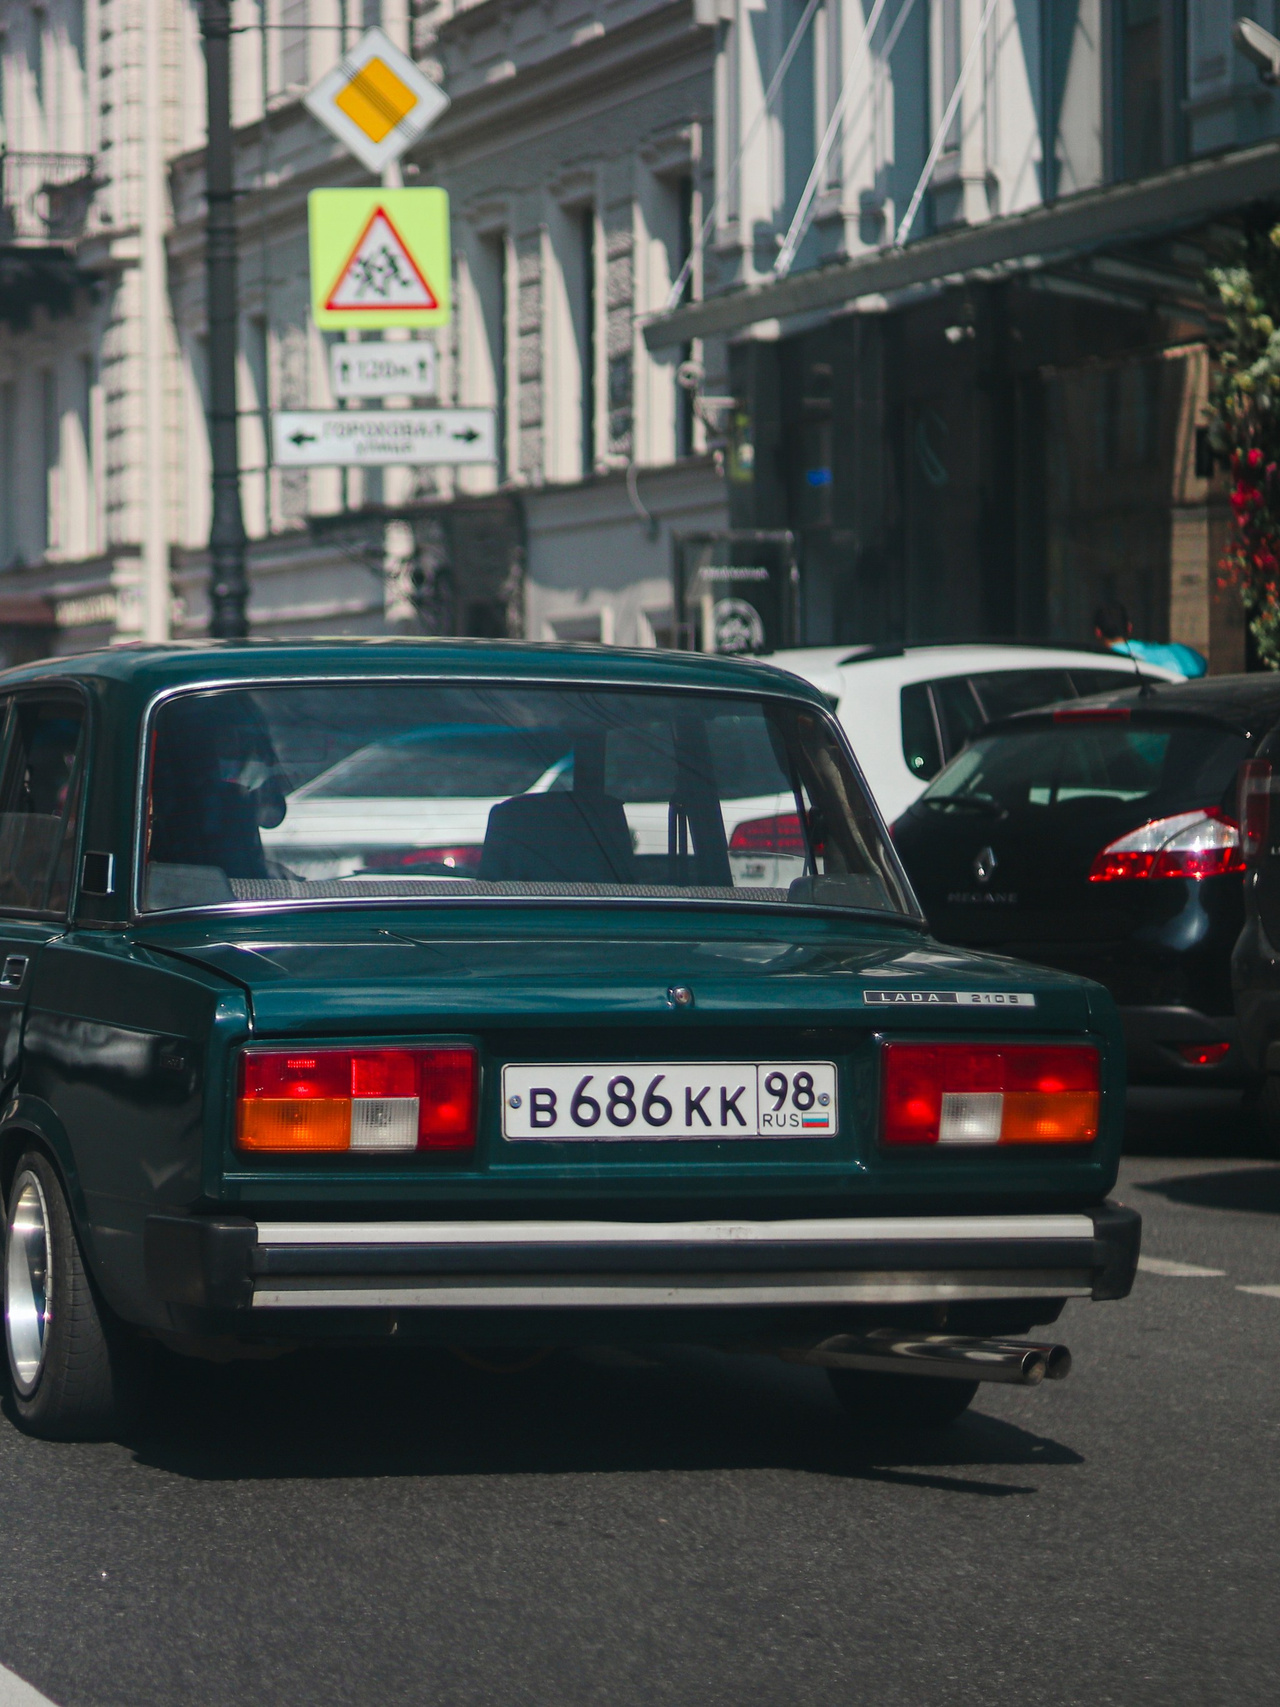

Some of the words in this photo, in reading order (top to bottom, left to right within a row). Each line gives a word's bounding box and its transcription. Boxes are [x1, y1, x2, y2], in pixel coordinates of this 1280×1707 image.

[323, 420, 443, 437] ГОРОХОВАЯ
[881, 992, 940, 1003] LADA
[970, 994, 1020, 1004] 2105
[764, 1070, 816, 1112] 98
[762, 1113, 800, 1128] RUS
